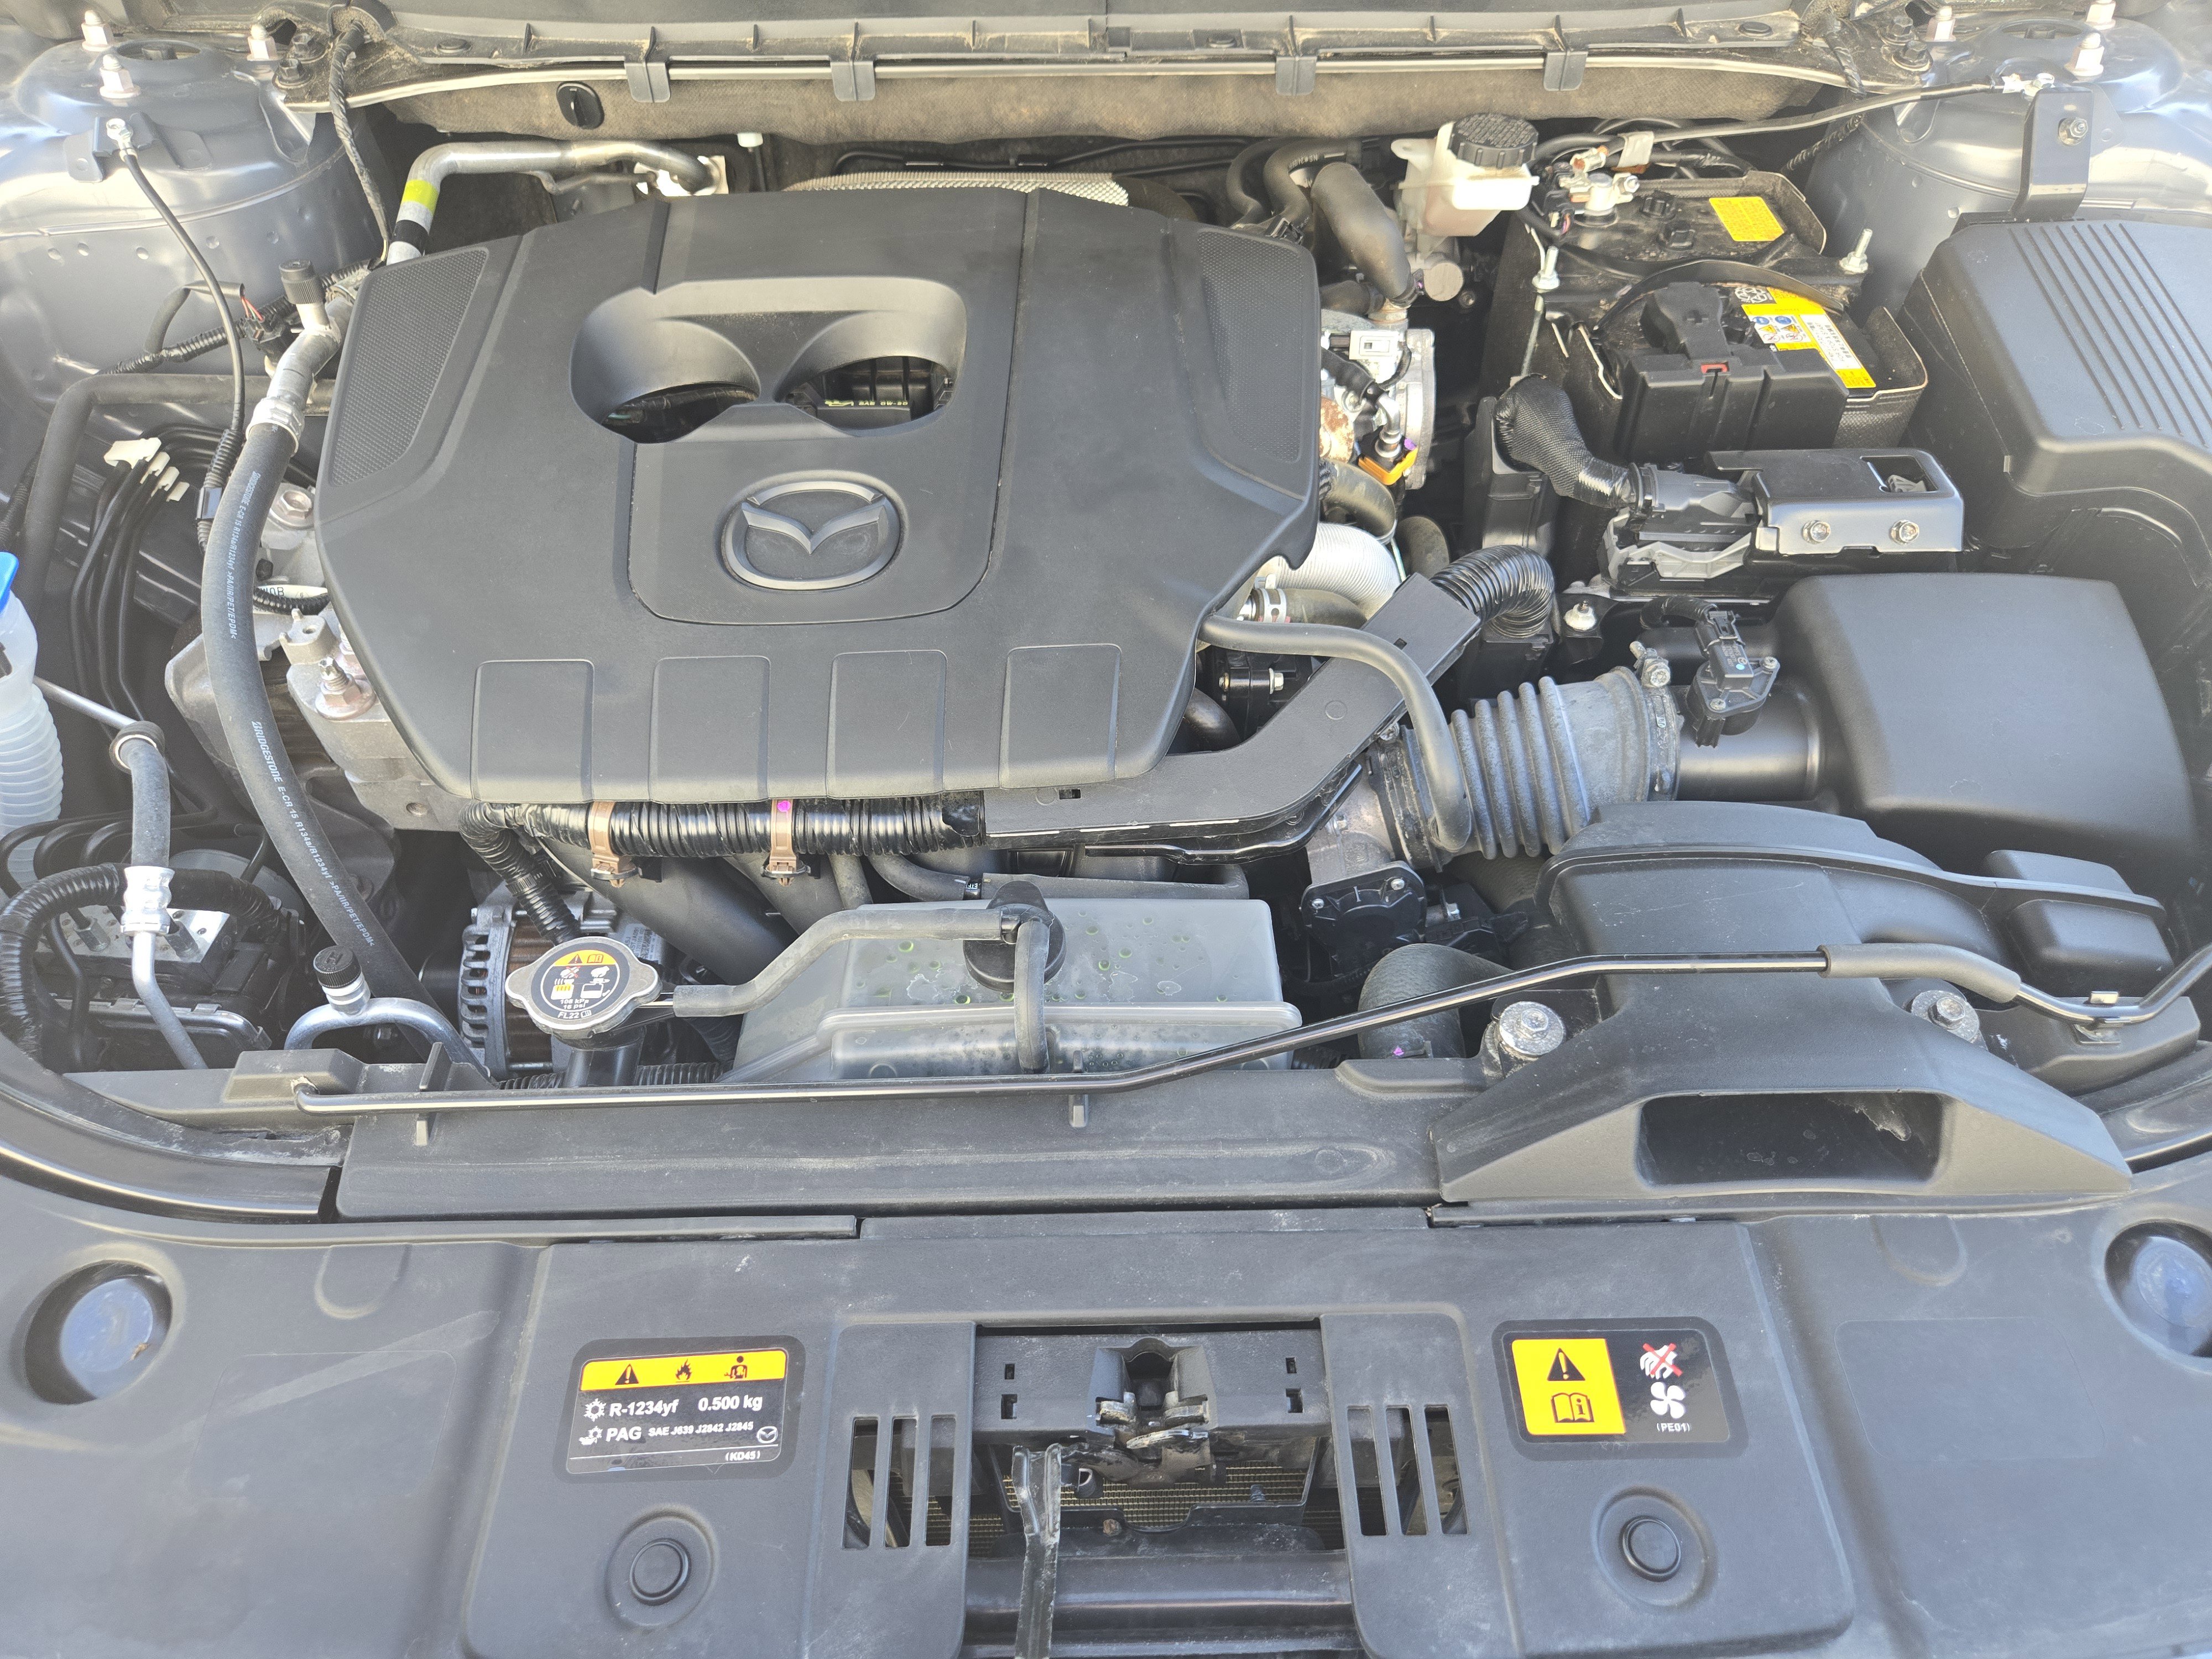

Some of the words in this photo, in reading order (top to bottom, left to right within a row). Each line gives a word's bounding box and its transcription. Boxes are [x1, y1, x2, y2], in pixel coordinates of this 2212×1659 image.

[242, 471, 260, 505] BRIDGESTONE
[252, 721, 283, 782] BRIDGESTONE
[278, 786, 294, 807] E-CR
[287, 808, 299, 819] 15
[295, 821, 333, 879] R134a/R1234yf
[609, 1399, 680, 1418] R-1234yf
[698, 1396, 739, 1412] 0.500
[743, 1394, 763, 1412] kg
[606, 1426, 642, 1442] PAG
[648, 1426, 669, 1437] SAE
[671, 1425, 694, 1436] J639
[696, 1423, 724, 1434] J2842
[726, 1421, 754, 1432] J2845
[1656, 1422, 1691, 1433] (PE01)
